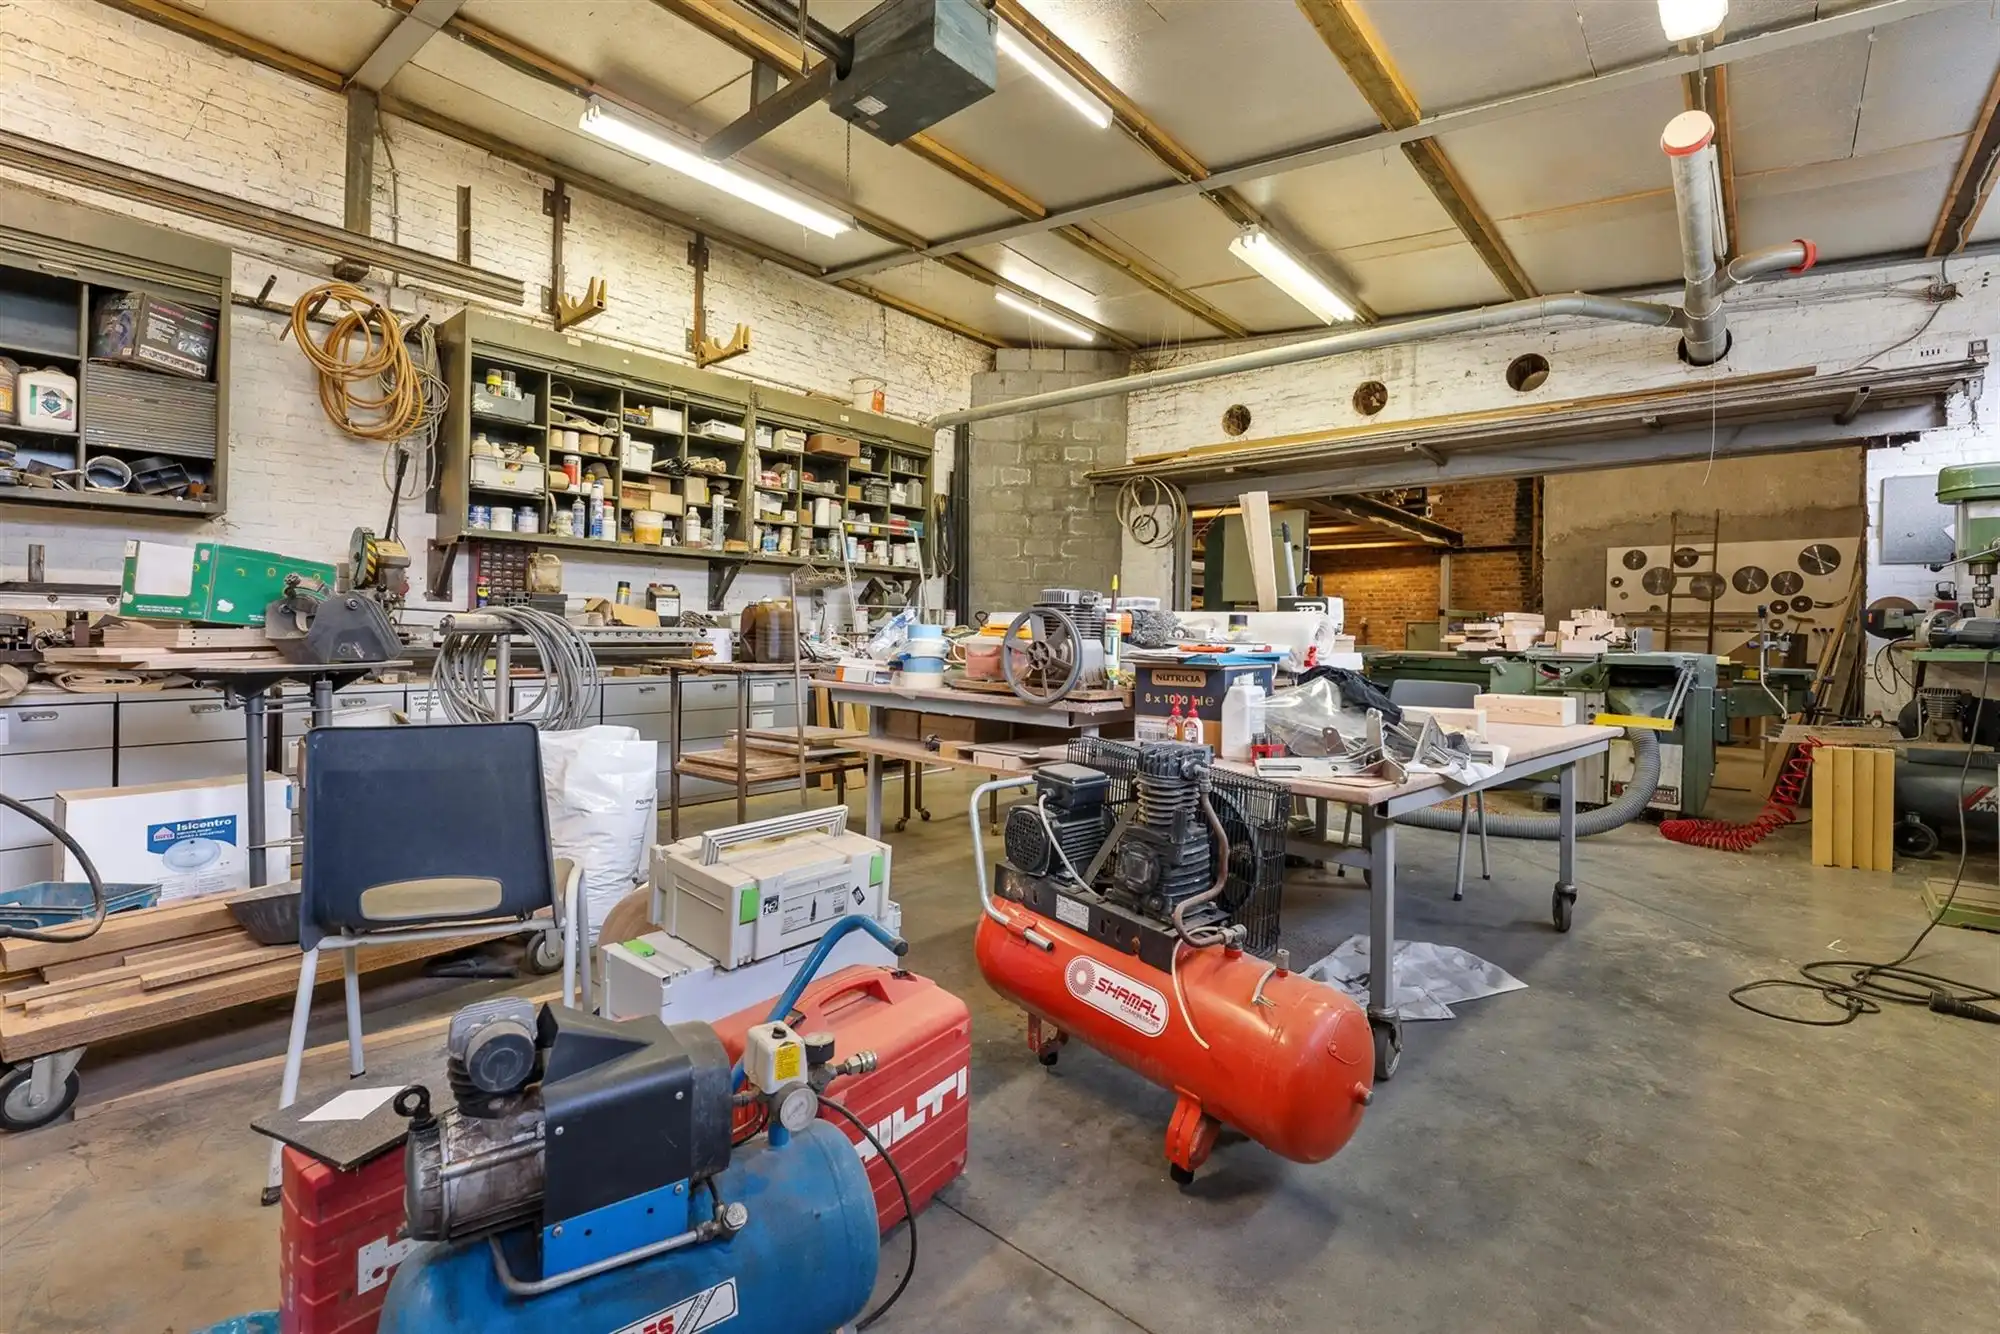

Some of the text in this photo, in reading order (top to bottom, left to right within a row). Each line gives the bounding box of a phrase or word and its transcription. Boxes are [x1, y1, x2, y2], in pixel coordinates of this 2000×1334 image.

[1155, 674, 1201, 683] NUTRICIA
[1145, 693, 1151, 702] 8
[176, 819, 232, 831] Isicentro
[1095, 977, 1160, 1021] SHAMAL
